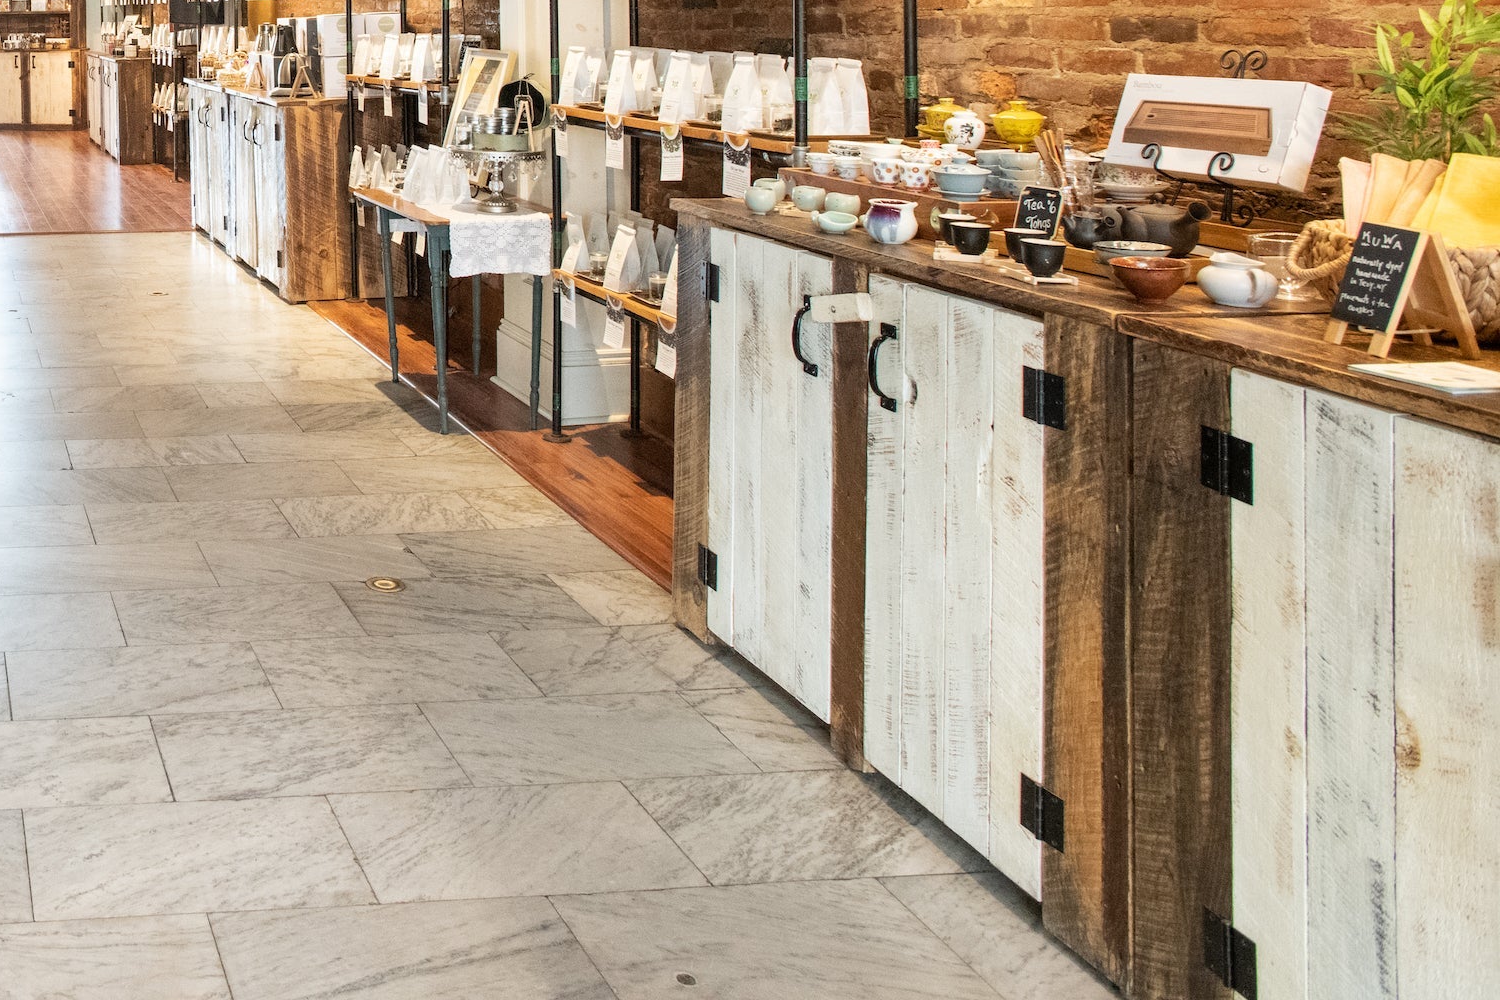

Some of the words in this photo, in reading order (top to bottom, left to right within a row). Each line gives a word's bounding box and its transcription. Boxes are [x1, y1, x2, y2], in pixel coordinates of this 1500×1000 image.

[1023, 198, 1046, 211] Tea
[1025, 215, 1052, 232] Tongs
[1361, 231, 1403, 251] KUWA
[1350, 277, 1357, 285] in
